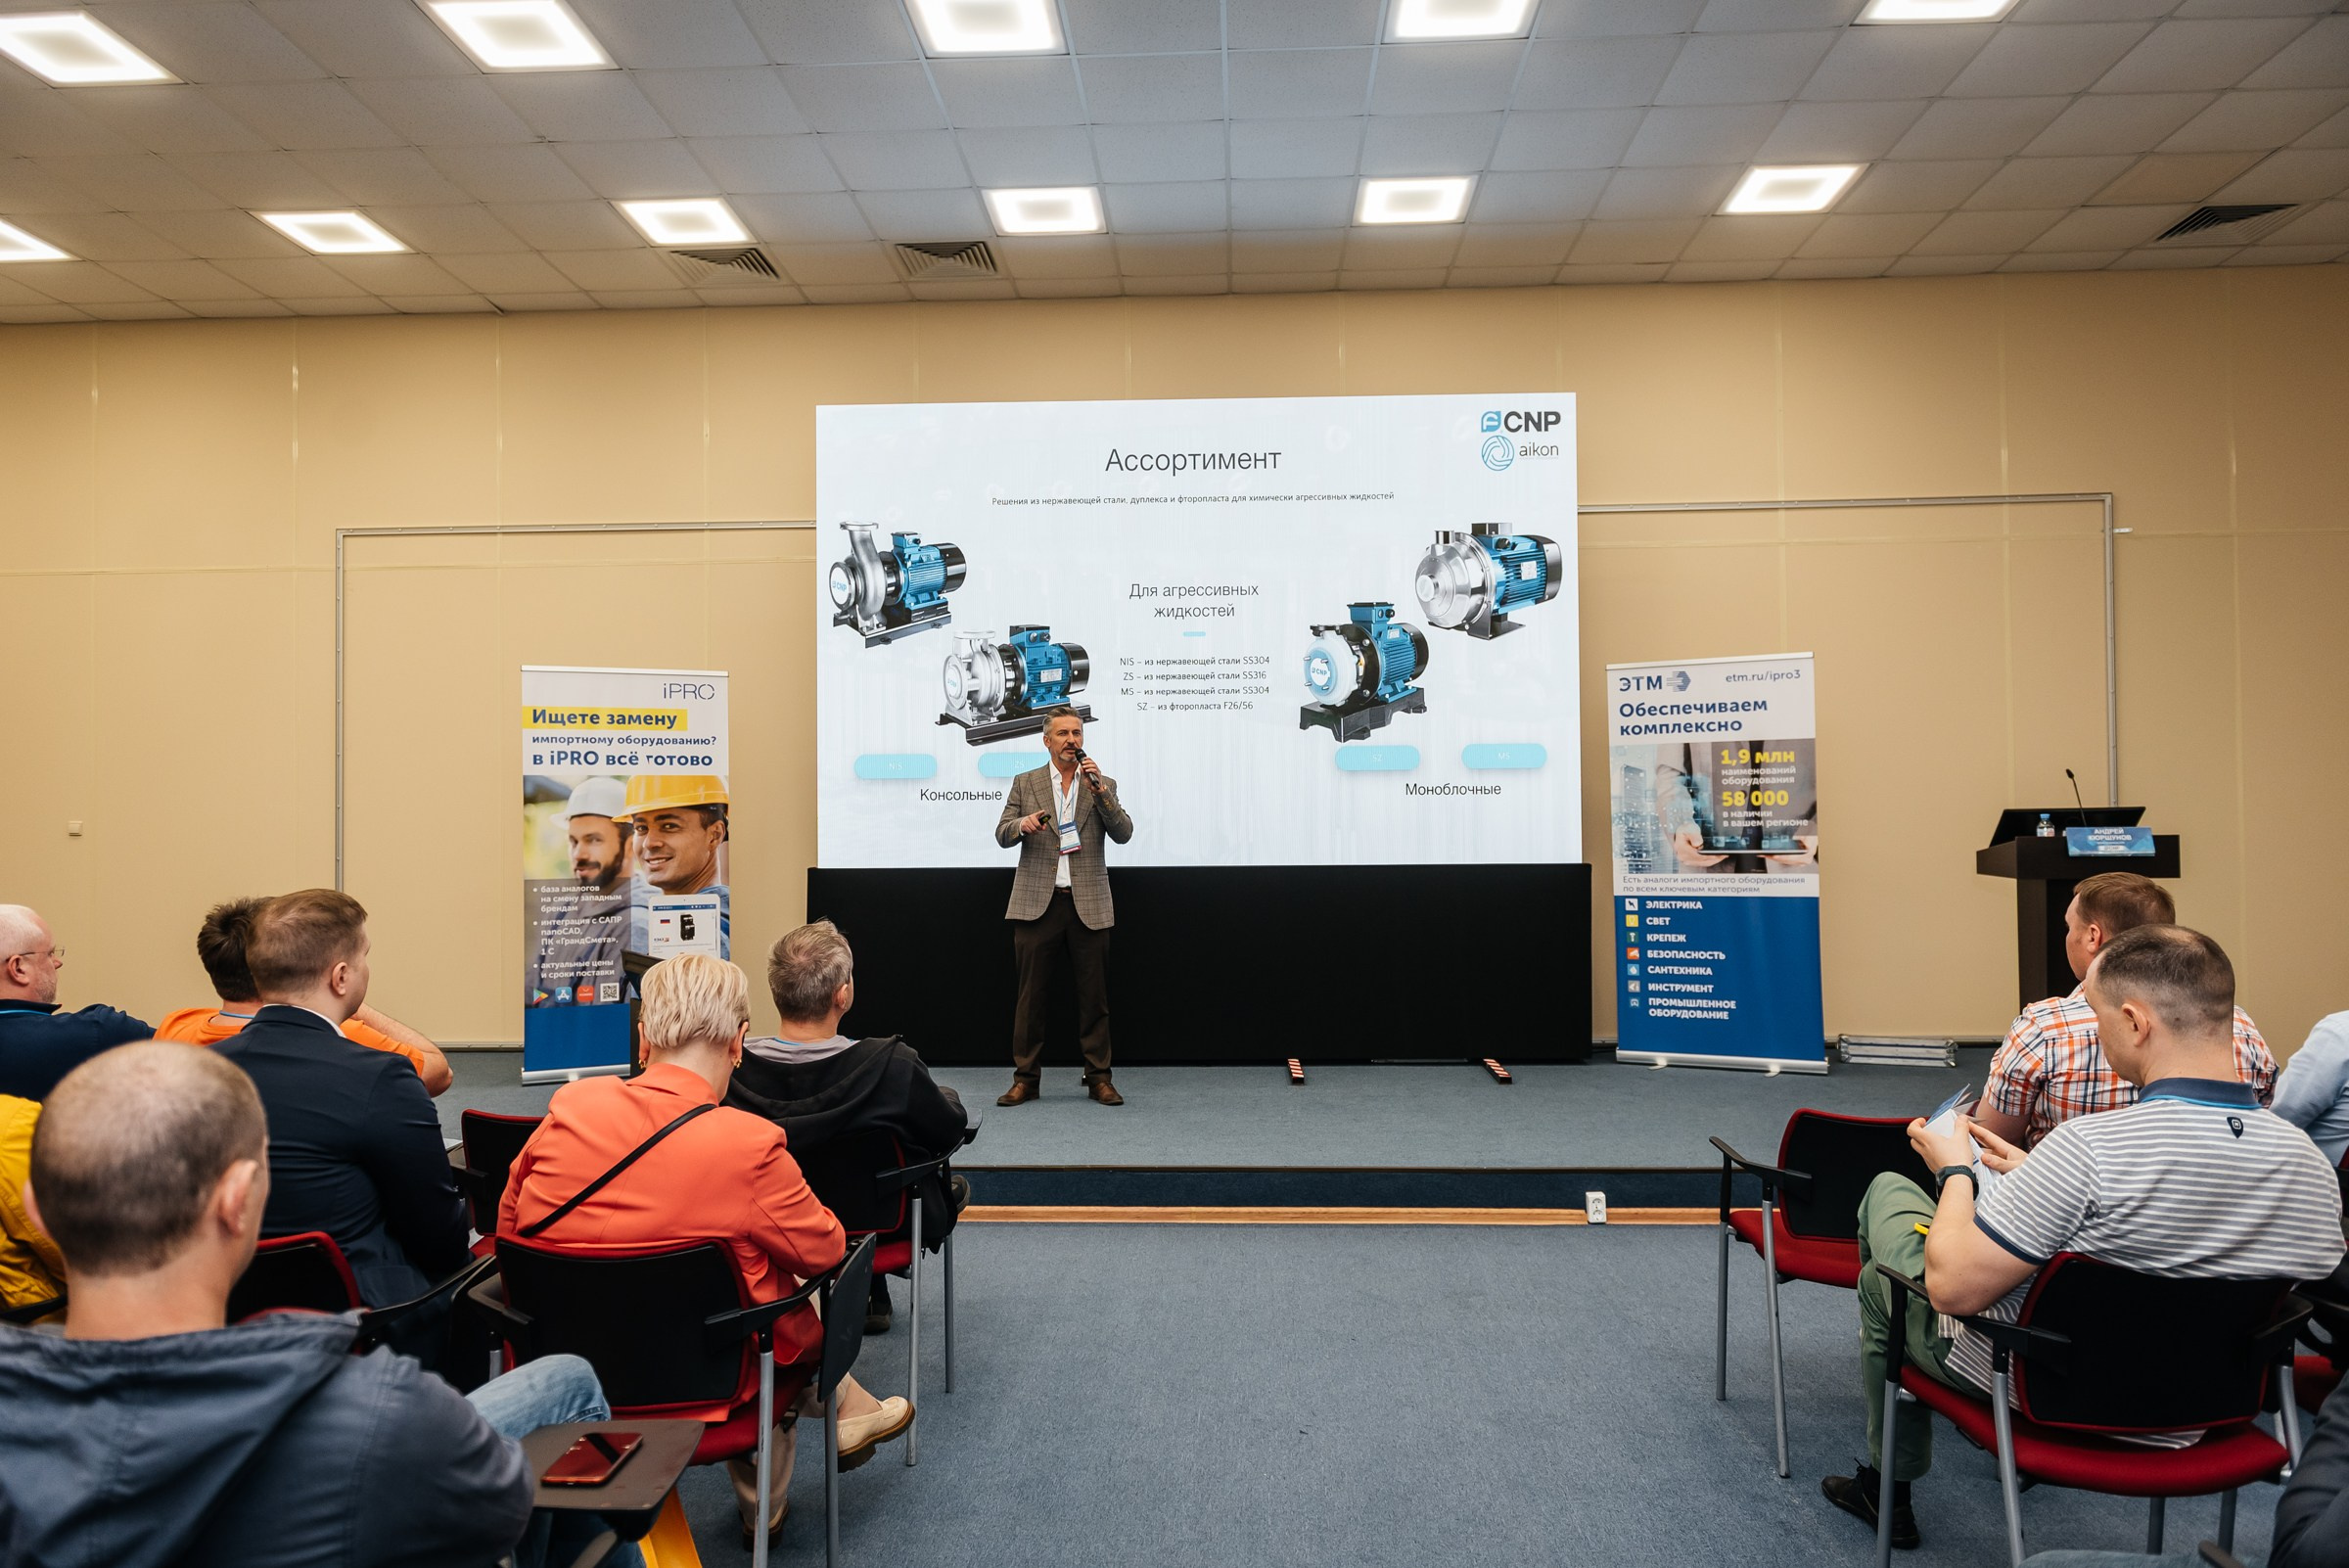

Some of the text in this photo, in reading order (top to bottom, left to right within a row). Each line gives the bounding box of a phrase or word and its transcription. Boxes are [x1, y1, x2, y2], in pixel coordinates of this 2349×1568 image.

[1504, 411, 1561, 433] CNP
[1519, 442, 1558, 456] aikon
[1105, 448, 1281, 477] Ассортимент
[1042, 496, 1101, 506] нержавеющей
[1130, 496, 1168, 505] дуплекса
[1178, 495, 1229, 504] фторопласта
[1296, 493, 1347, 502] агрессивных
[1350, 492, 1394, 501] жидкостей
[1129, 583, 1259, 599] Для агрессивных
[1154, 603, 1235, 620] жидкостей
[1157, 657, 1216, 667] нержавеющей
[1156, 671, 1216, 681] нержавеющей
[1316, 668, 1328, 676] CNP
[1726, 669, 1801, 683] etm.ru/ipro3
[1619, 675, 1663, 692] ЭТМ
[664, 683, 714, 700] iPRO
[1156, 687, 1216, 696] нержавеющей
[1170, 702, 1221, 712] фторопласта
[1619, 698, 1768, 716] Обеспечиваем
[532, 709, 677, 729] Ищете замену
[1620, 719, 1742, 735] комплексно
[532, 735, 716, 747] импортному оборудованию?
[533, 751, 714, 766] в iPRO всё готово
[1722, 749, 1795, 765] 1,9 млн
[1722, 766, 1796, 775] наименований
[1722, 776, 1795, 786] оборудования
[920, 788, 1002, 801] Консольные
[1405, 782, 1501, 796] Моноблочные
[1723, 790, 1789, 807] 58 000
[1766, 819, 1809, 828] регионе
[1738, 876, 1805, 885] оборудования
[1708, 886, 1760, 895] категориям
[553, 896, 578, 904] смену
[580, 895, 622, 903] западным
[1646, 900, 1703, 909] ЭЛЕКТРИКА
[541, 904, 578, 913] брендам
[541, 918, 590, 927] интеграция
[541, 927, 582, 936] nanoCAD,
[1647, 950, 1726, 960] БЕЗОПАСНОСТЬ
[541, 959, 614, 970] актуальные цены
[549, 971, 574, 980] сроки
[576, 969, 615, 978] поставки
[1648, 966, 1713, 976] САНТЕХНИКА
[1648, 984, 1714, 992] ИНСТРУМЕНТ
[1648, 998, 1736, 1009] ПРОМЫШЛЕННОЕ
[1649, 1009, 1728, 1020] ОБОРУДОВАНИЕ
